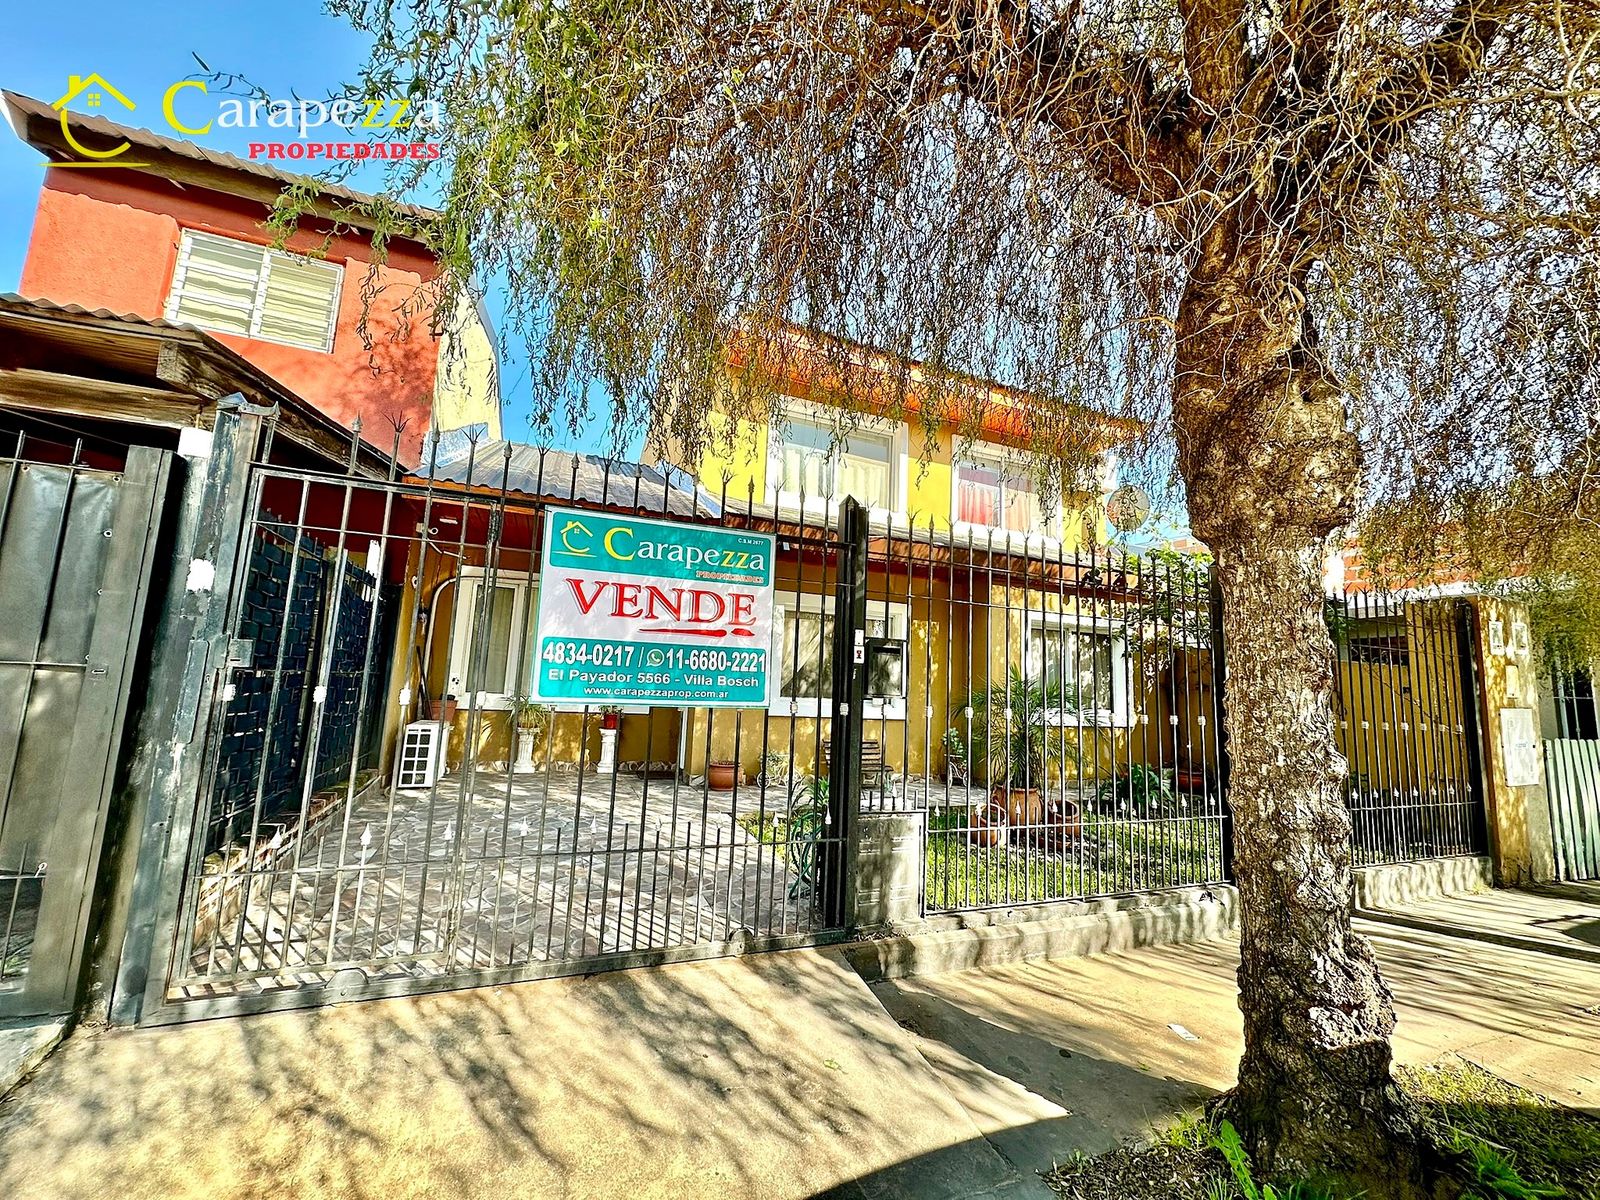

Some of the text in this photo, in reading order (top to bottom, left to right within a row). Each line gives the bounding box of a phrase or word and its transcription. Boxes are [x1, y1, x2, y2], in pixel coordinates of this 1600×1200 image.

[603, 527, 765, 571] Carapezza
[565, 577, 757, 626] VENDE
[542, 641, 635, 667] 4834-0217
[666, 647, 766, 673] 11-6680-2221
[548, 668, 564, 681] El
[569, 669, 633, 684] Payador
[637, 672, 671, 684] 5566
[684, 673, 713, 686] Villa
[717, 675, 759, 687] Bosch
[583, 686, 729, 698] www.carapezzaprop.com.ar
